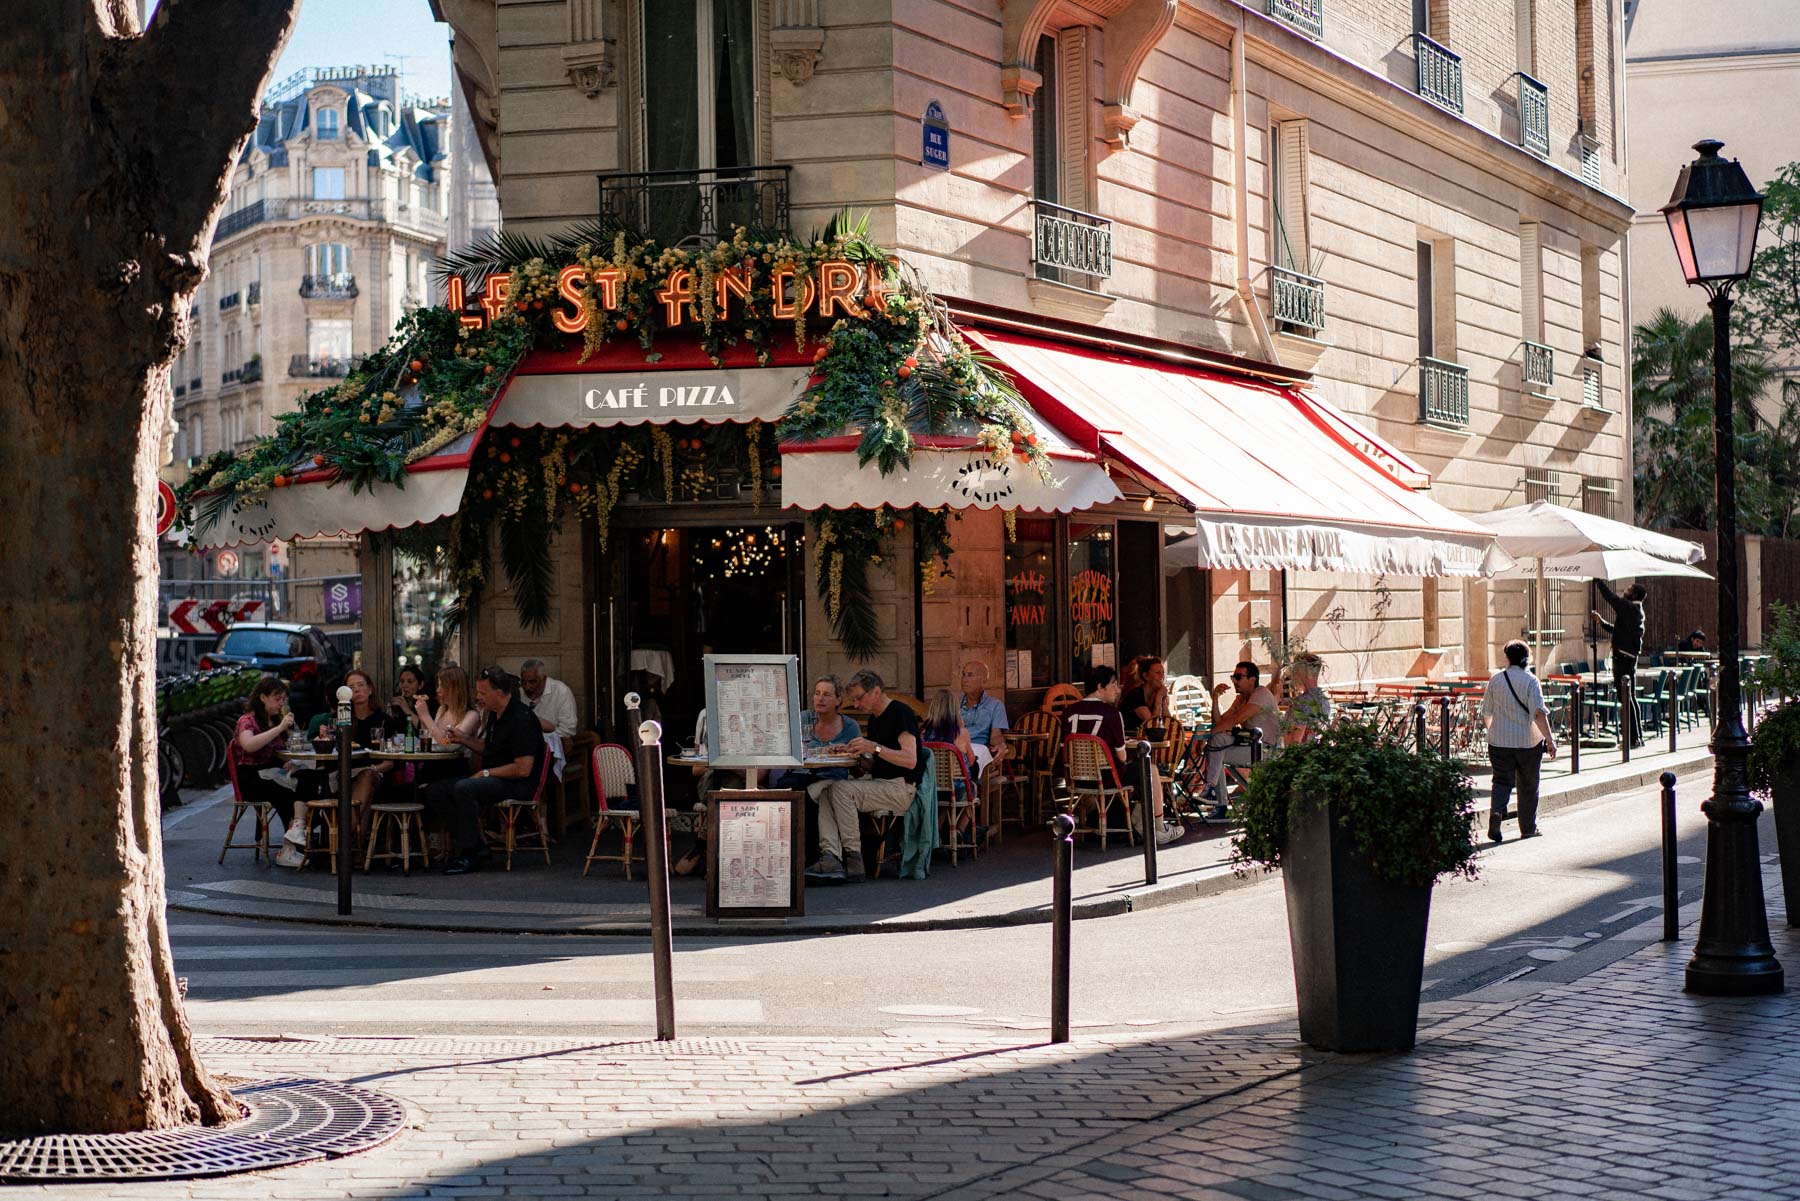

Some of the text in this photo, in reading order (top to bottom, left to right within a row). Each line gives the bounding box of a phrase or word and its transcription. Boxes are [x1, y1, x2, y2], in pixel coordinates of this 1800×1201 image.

[925, 146, 947, 161] SUGER
[448, 275, 513, 330] LE
[553, 264, 627, 334] ST
[585, 383, 735, 410] CAFÉ PIZZA
[952, 480, 1014, 503] CONTINU
[1216, 524, 1236, 554] LE
[1242, 526, 1289, 556] SAINT
[1521, 566, 1581, 574] TAITINGER
[1012, 570, 1046, 595] TAKE
[1071, 569, 1112, 598] SERVICE
[331, 601, 350, 614] SYS
[1011, 605, 1046, 625] AWAY
[1071, 602, 1113, 621] CONTINU
[1068, 713, 1104, 736] 17
